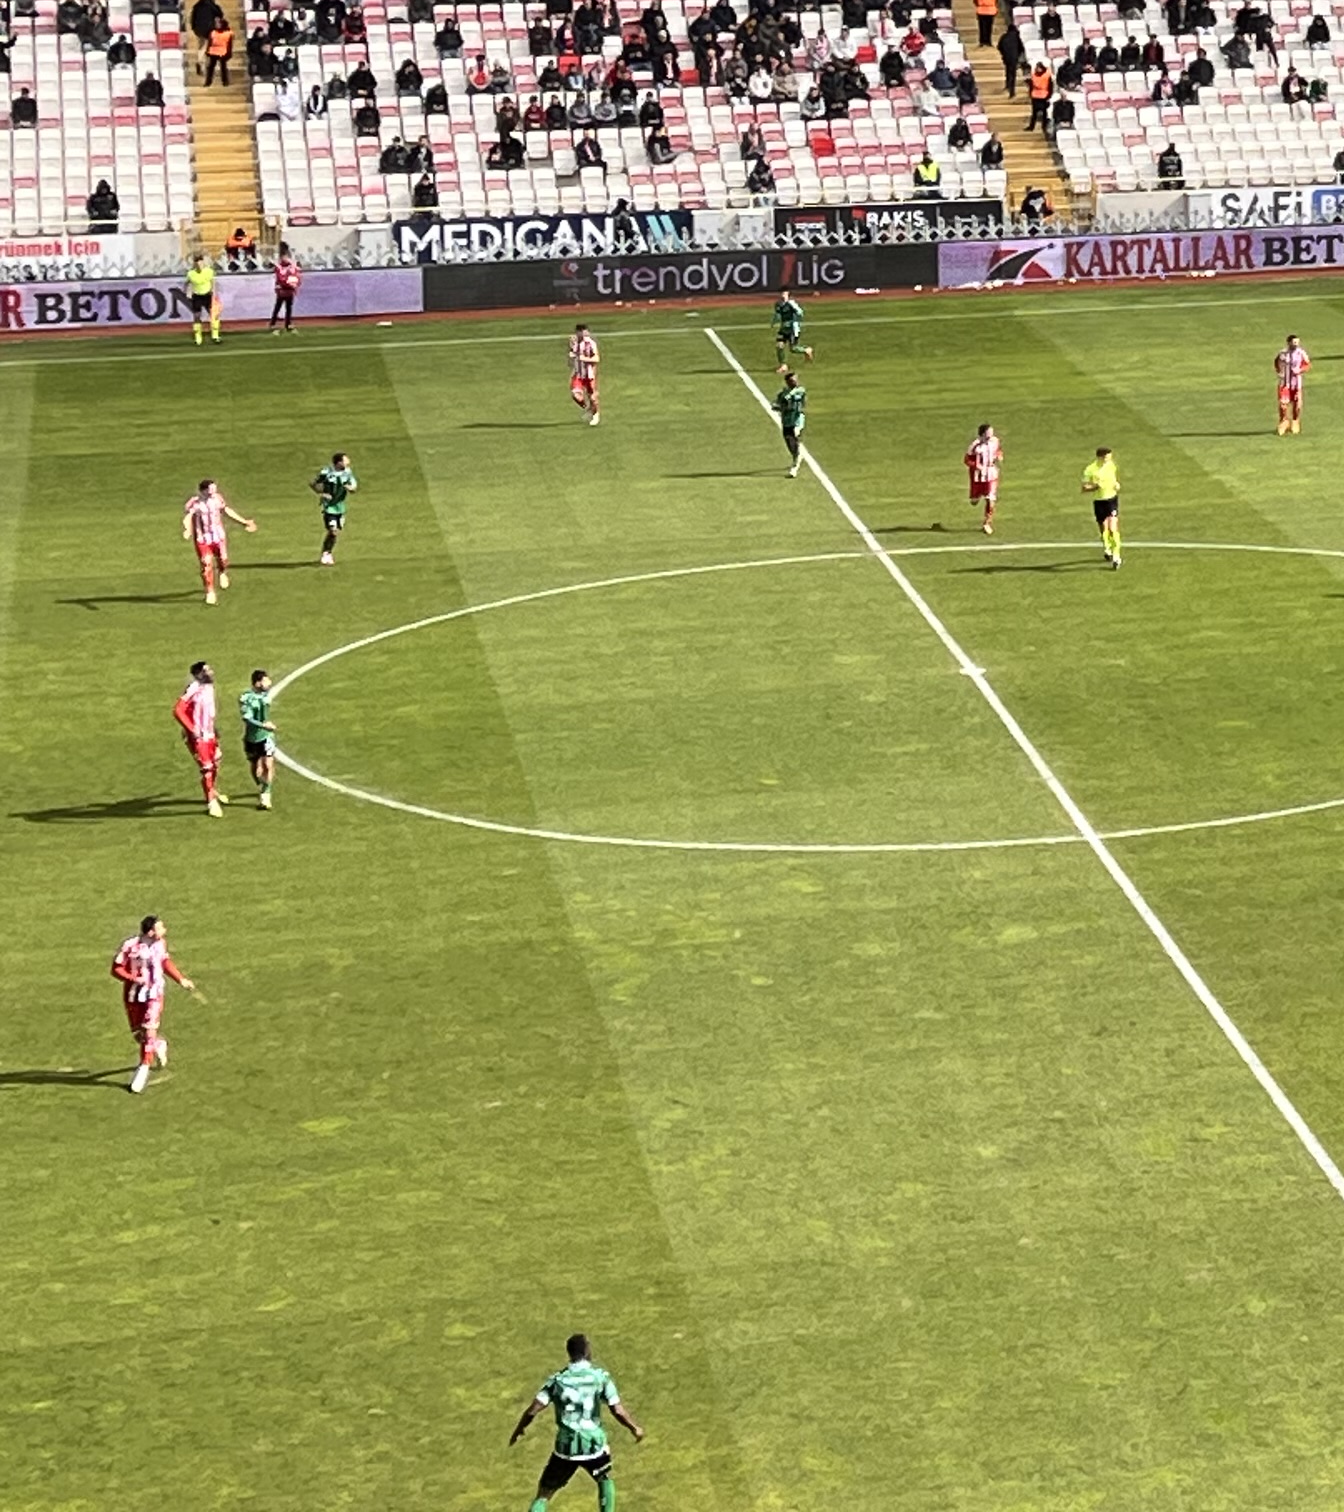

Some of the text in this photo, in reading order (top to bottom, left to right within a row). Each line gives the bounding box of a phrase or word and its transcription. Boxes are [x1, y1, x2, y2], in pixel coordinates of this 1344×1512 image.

[592, 256, 769, 295] trendyol
[1063, 233, 1256, 280] KARTALLAR
[33, 286, 196, 326] BETON
